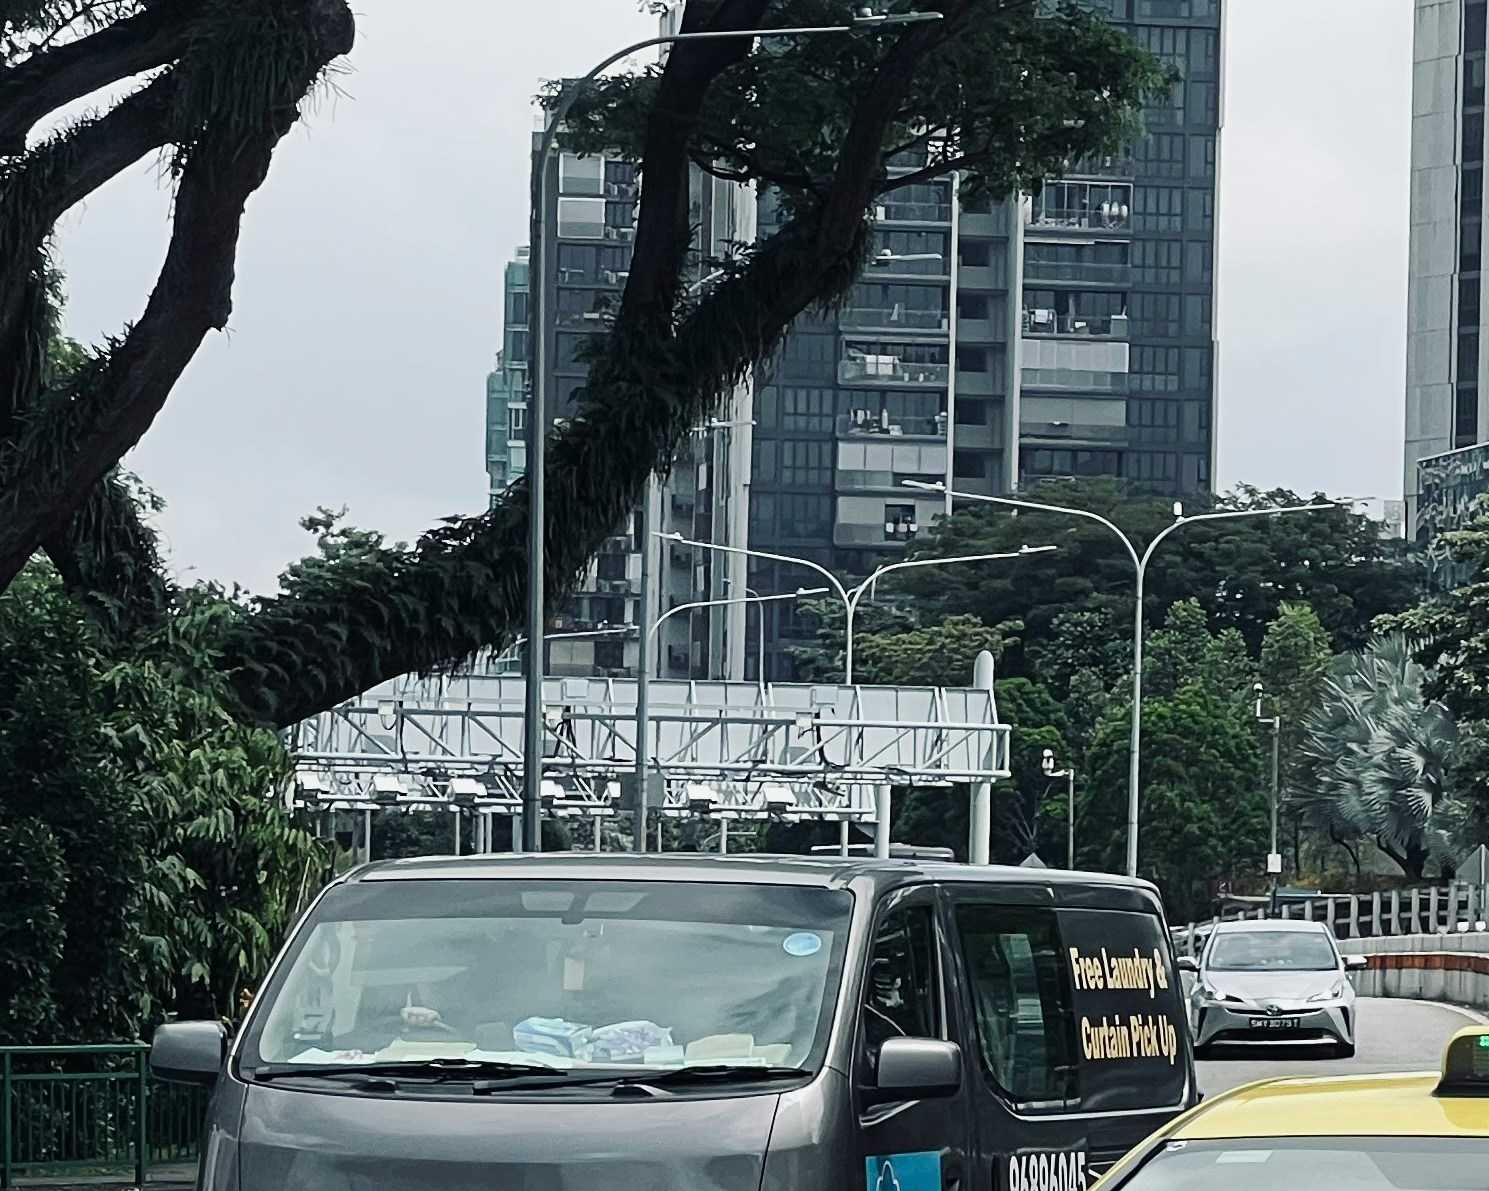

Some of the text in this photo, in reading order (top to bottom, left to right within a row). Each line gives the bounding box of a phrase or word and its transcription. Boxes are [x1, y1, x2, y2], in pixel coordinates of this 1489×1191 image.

[1068, 946, 1169, 999] Free Laundry &
[1081, 1013, 1177, 1065] Curtain Pick Up
